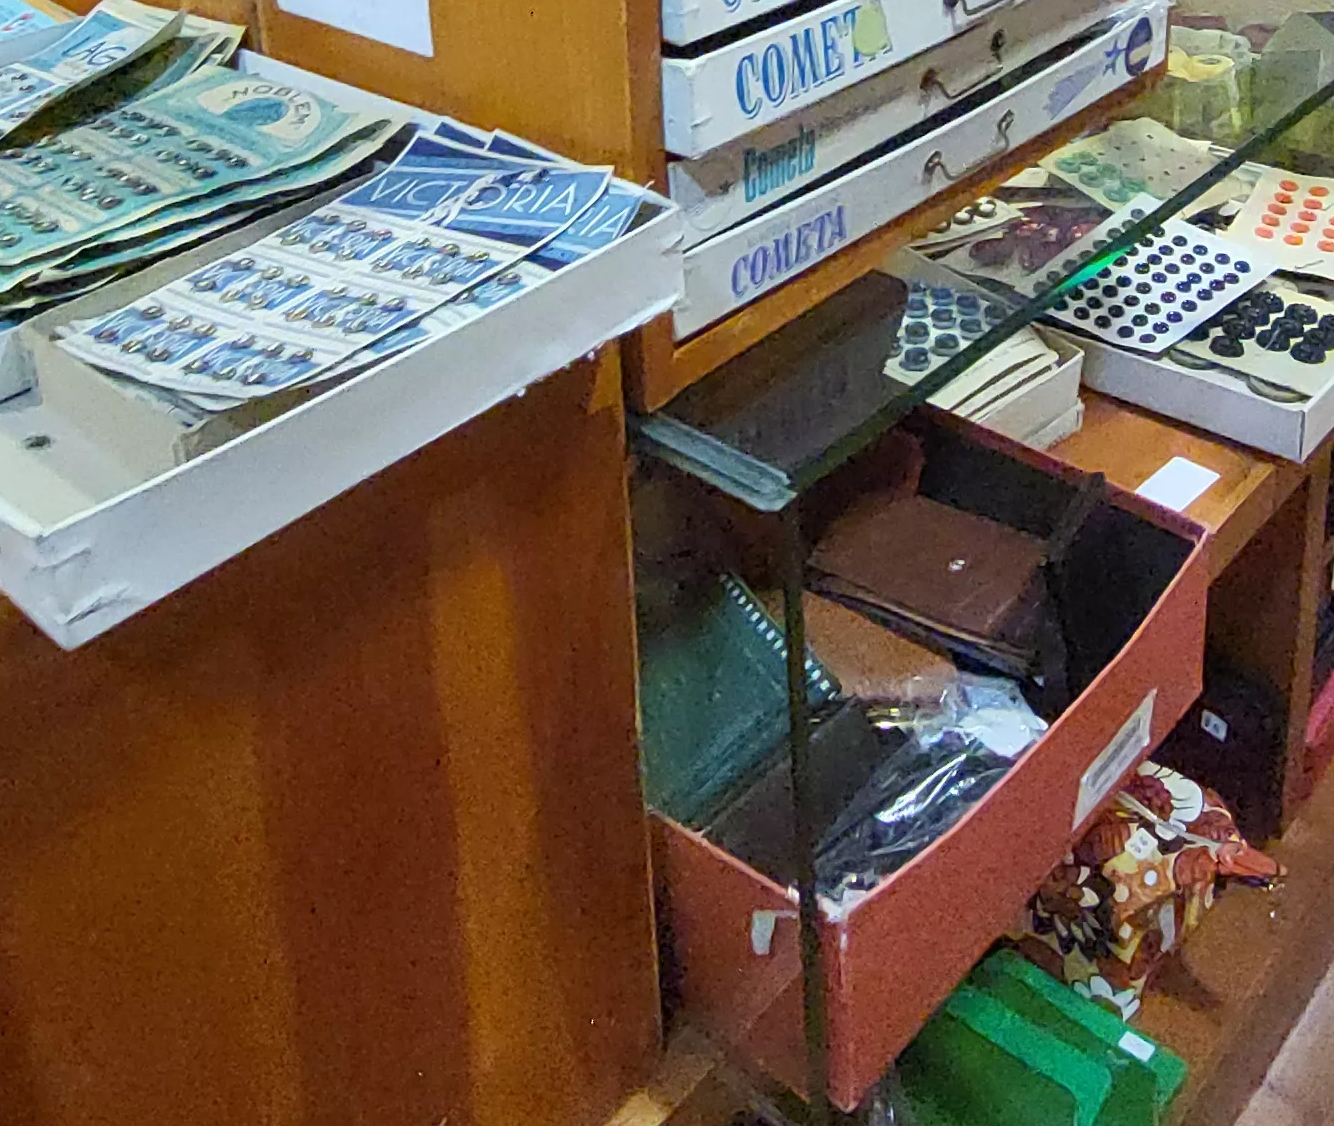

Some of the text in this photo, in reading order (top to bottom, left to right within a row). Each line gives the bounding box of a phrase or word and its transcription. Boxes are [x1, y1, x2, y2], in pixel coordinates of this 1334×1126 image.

[736, 5, 893, 120] COMET
[743, 124, 816, 203] Cometa
[731, 205, 848, 298] COMETA
